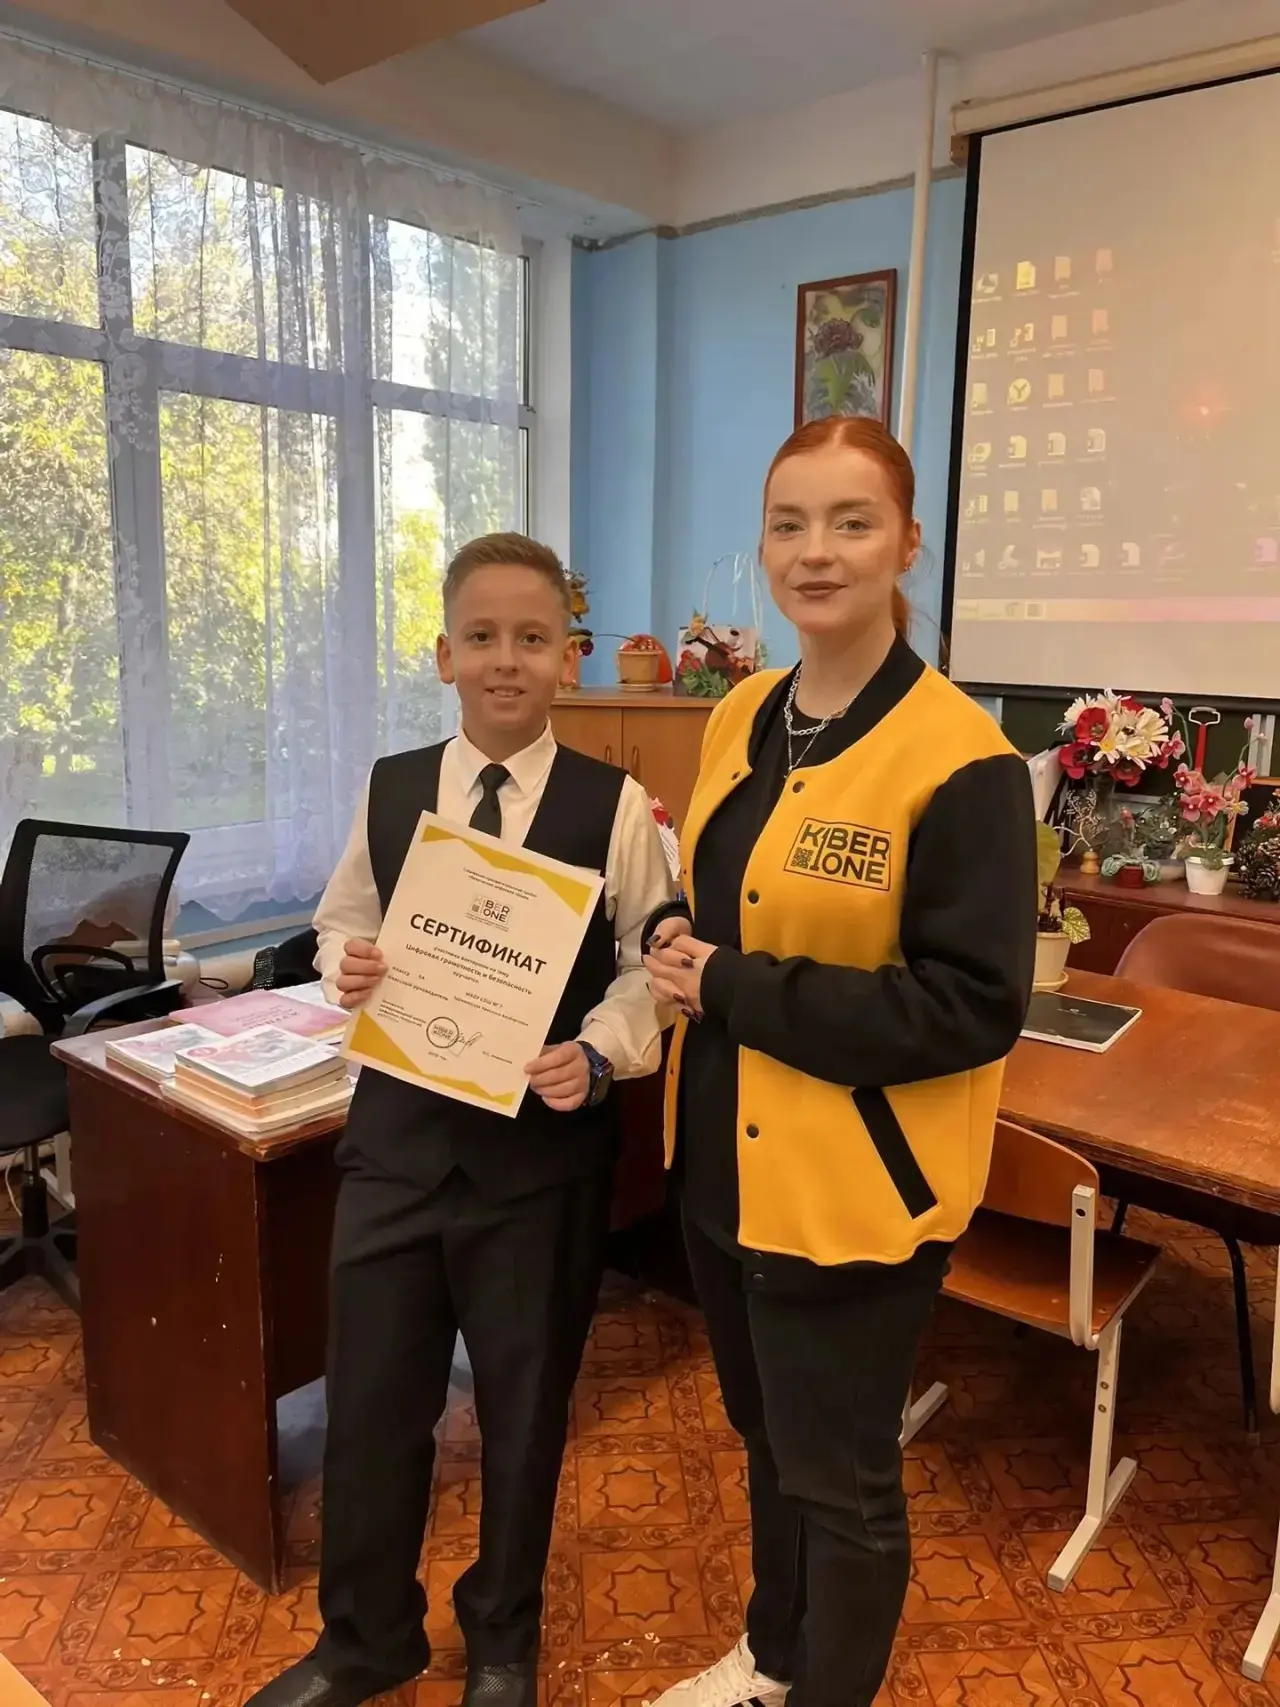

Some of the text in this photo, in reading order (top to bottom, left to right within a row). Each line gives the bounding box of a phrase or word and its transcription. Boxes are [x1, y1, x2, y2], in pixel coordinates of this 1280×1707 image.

[822, 852, 886, 885] ONE
[483, 908, 508, 923] ONE
[410, 913, 547, 975] СЕРТИФИКАТ
[405, 943, 439, 960] Цифровая
[440, 956, 481, 977] грамотность
[488, 973, 533, 995] безопасность
